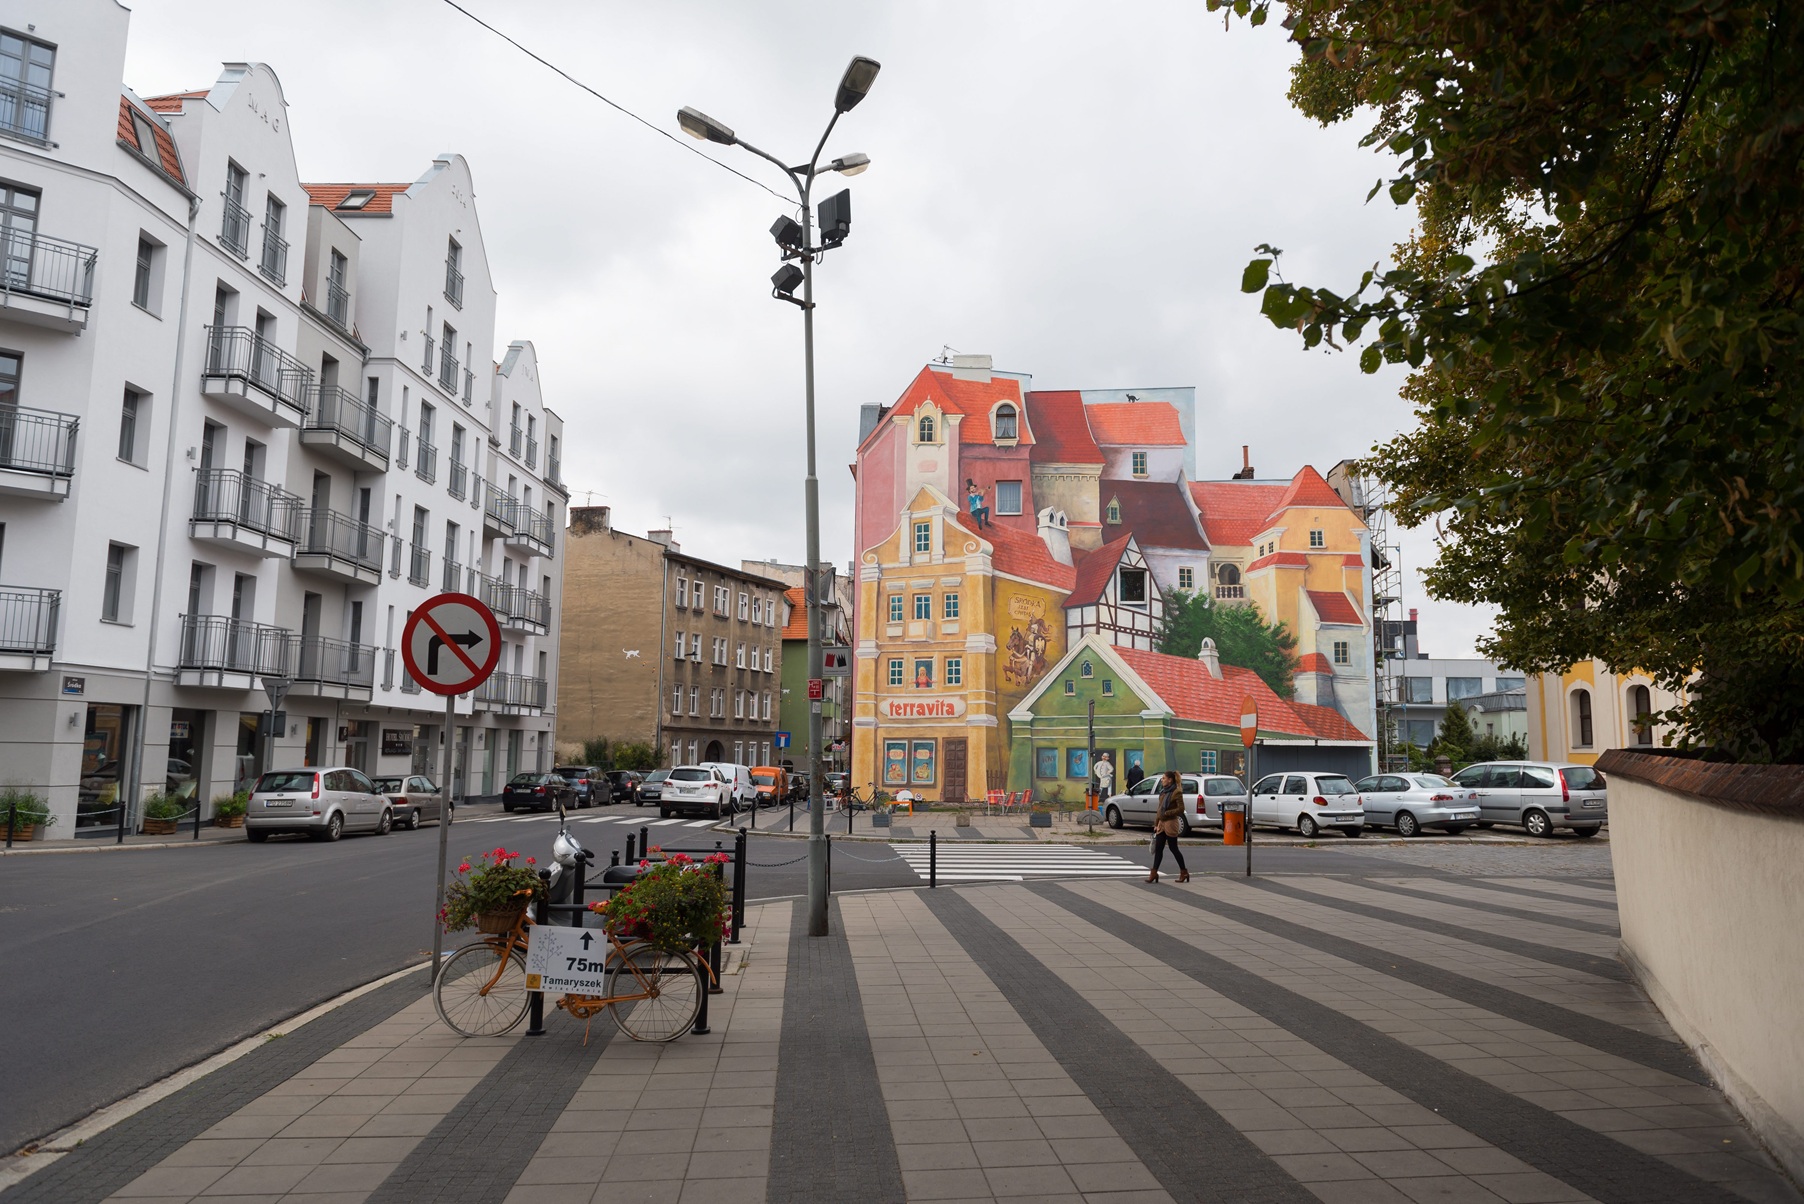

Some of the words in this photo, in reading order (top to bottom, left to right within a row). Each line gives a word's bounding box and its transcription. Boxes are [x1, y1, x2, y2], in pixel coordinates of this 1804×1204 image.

[889, 699, 955, 716] terravita
[566, 957, 604, 973] 75m
[543, 975, 602, 988] Tamaryszek
